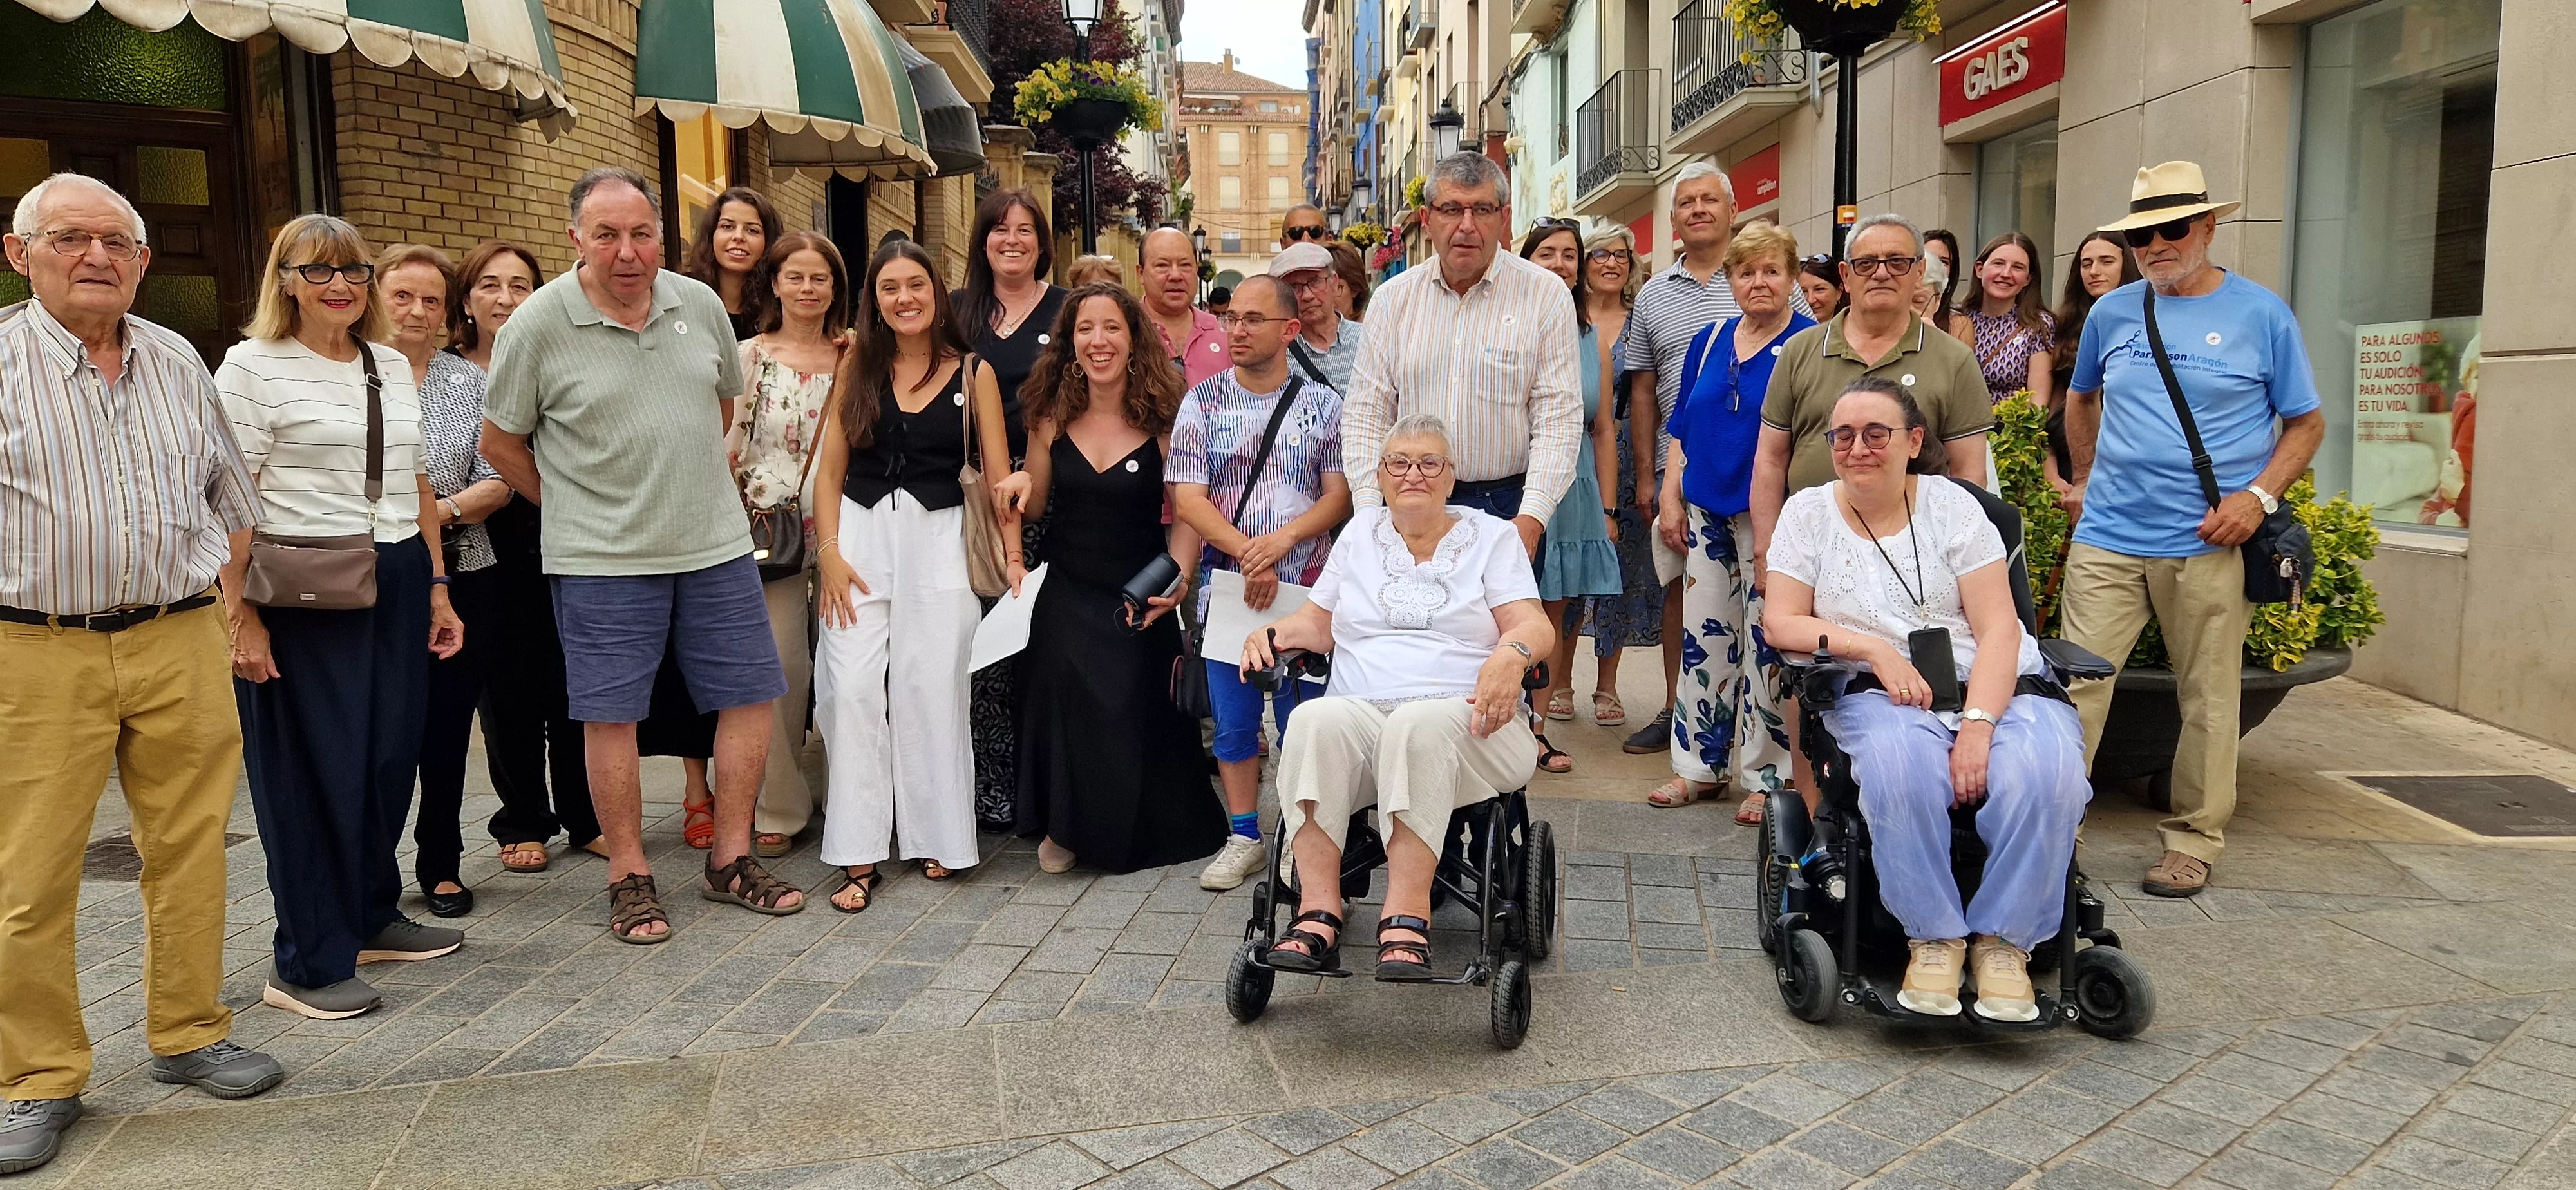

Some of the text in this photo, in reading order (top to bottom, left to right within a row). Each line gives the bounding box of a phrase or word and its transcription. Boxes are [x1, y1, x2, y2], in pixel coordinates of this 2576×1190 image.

[1963, 36, 2029, 101] GAES
[2362, 335, 2385, 347] PARA
[2360, 350, 2401, 364] ES SOLO
[2360, 368, 2372, 380] TU
[2359, 384, 2382, 395] PARA
[2358, 400, 2411, 412] ES TU VIDA.
[2376, 419, 2396, 428] ahora
[2396, 422, 2401, 430] y
